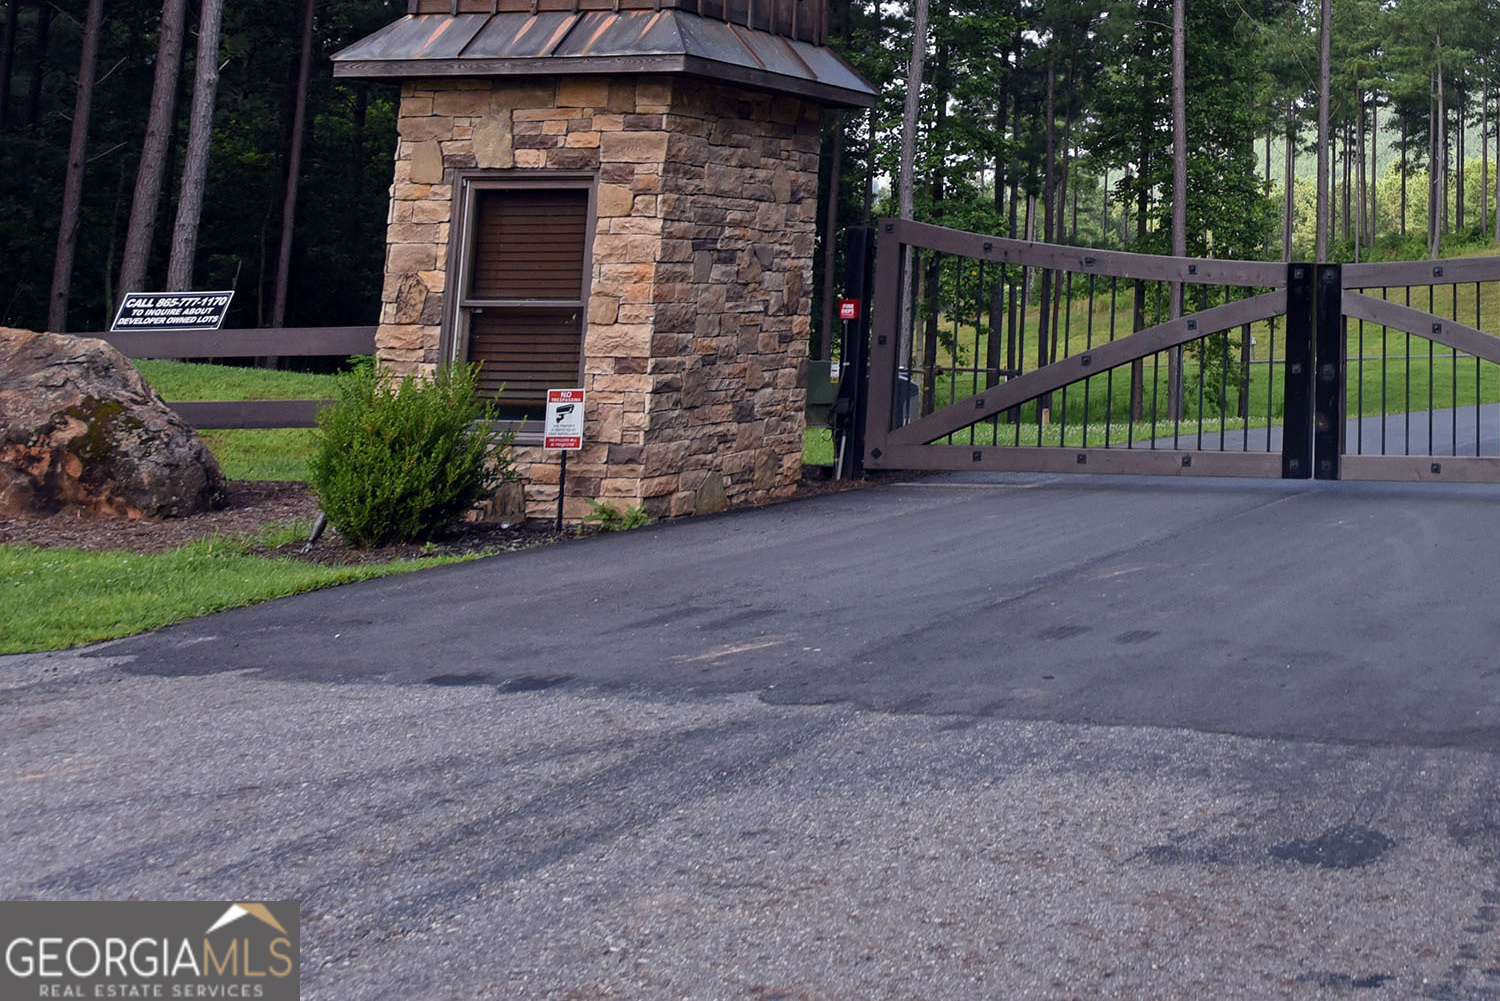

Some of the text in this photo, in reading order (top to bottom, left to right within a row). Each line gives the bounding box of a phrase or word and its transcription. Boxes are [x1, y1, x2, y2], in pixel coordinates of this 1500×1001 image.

[126, 296, 228, 308] CALL 865-777-1170
[144, 308, 181, 316] INQUIRE
[182, 307, 215, 315] ABOUT
[117, 315, 220, 325] DEVELOPER OWNED LOTS
